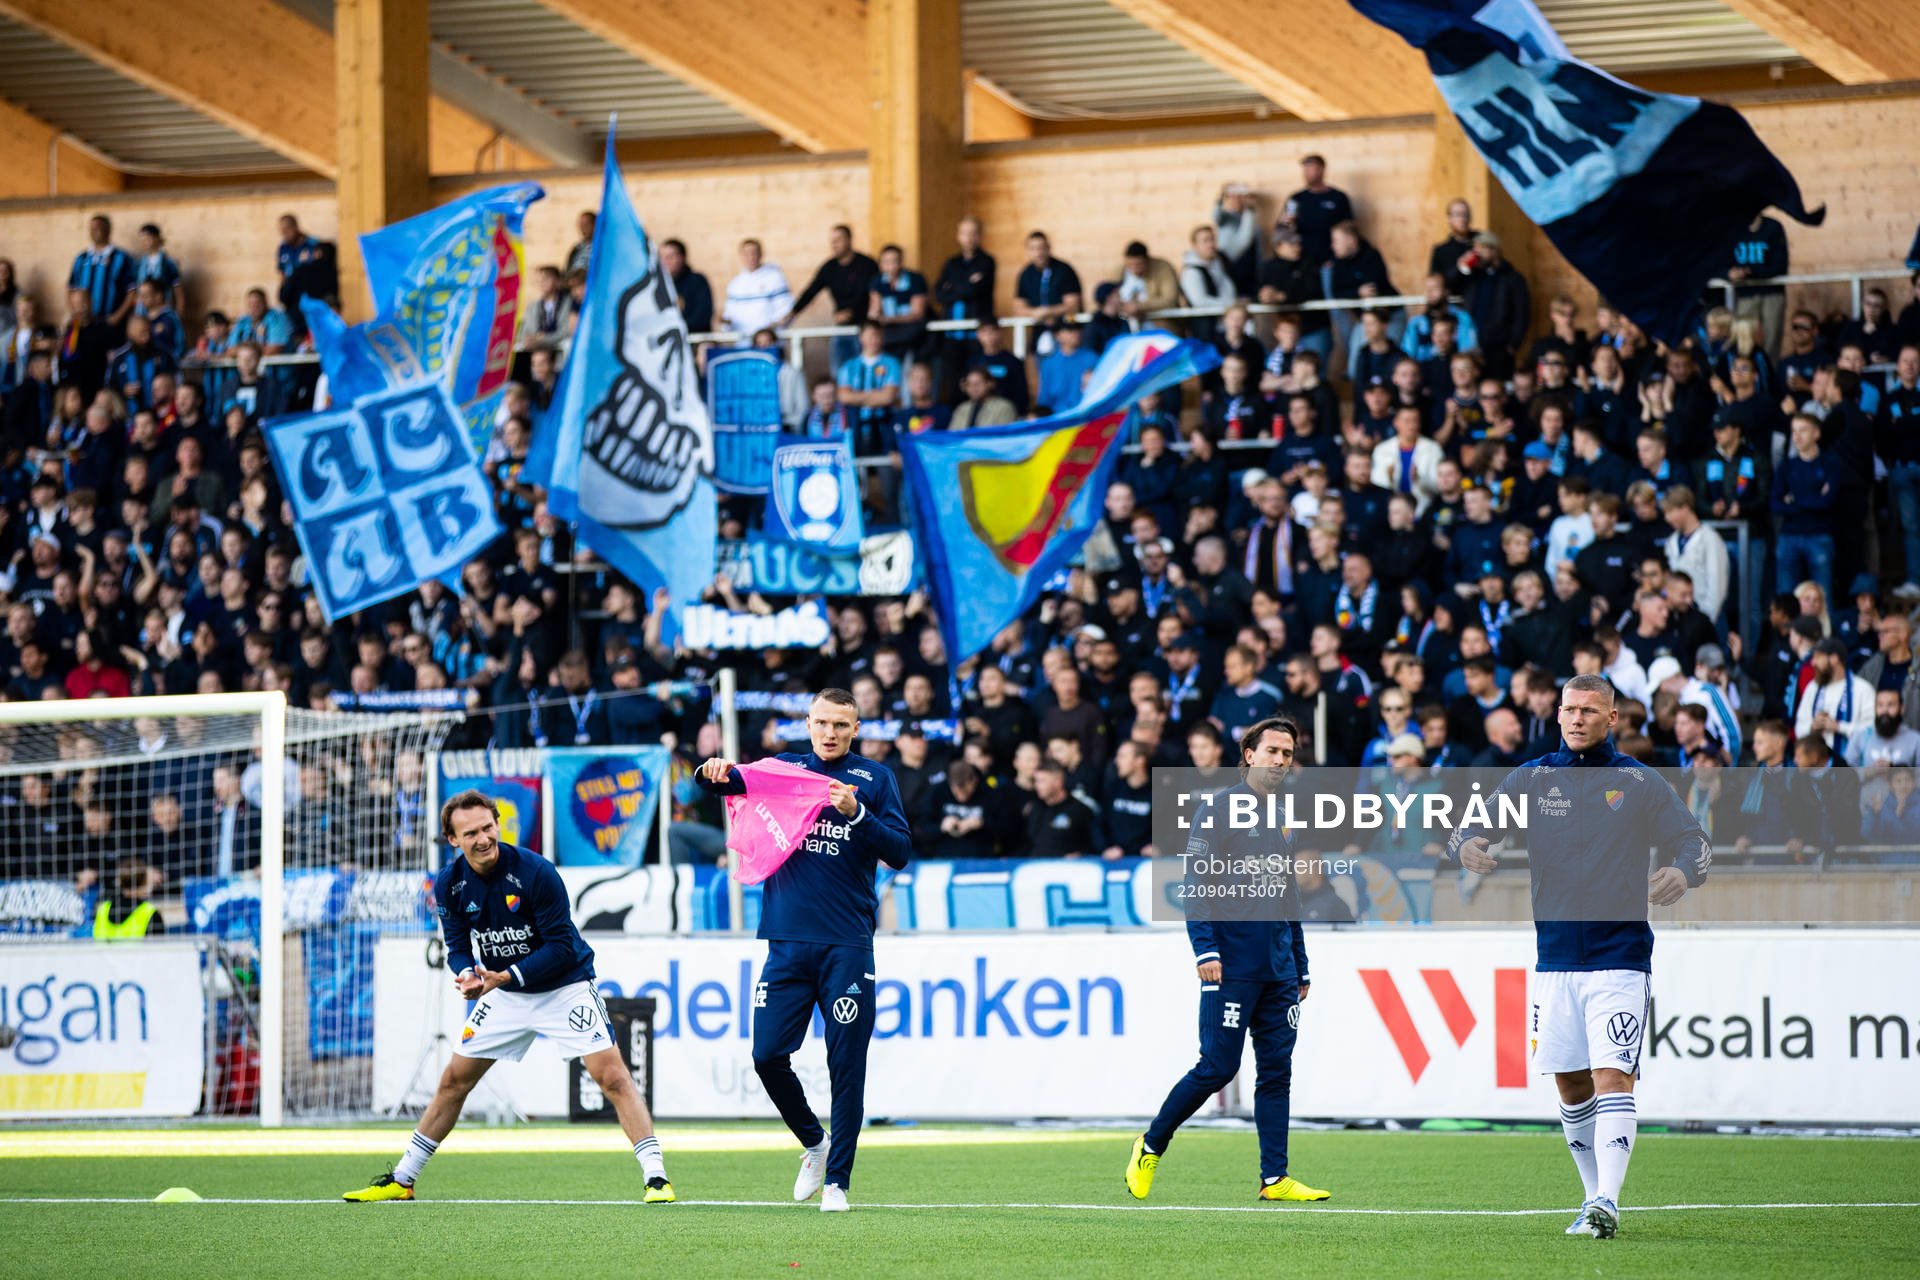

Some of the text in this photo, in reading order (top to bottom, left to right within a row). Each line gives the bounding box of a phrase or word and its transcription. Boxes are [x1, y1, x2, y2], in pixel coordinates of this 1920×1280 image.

[441, 748, 542, 780] ONE LOV
[1537, 796, 1572, 809] Prioritet
[1540, 806, 1567, 817] Finans
[808, 819, 852, 841] ritet
[797, 837, 840, 856] nans
[471, 923, 535, 943] Prioritet
[481, 942, 531, 958] Finans
[1648, 995, 1920, 1060] ksala m
